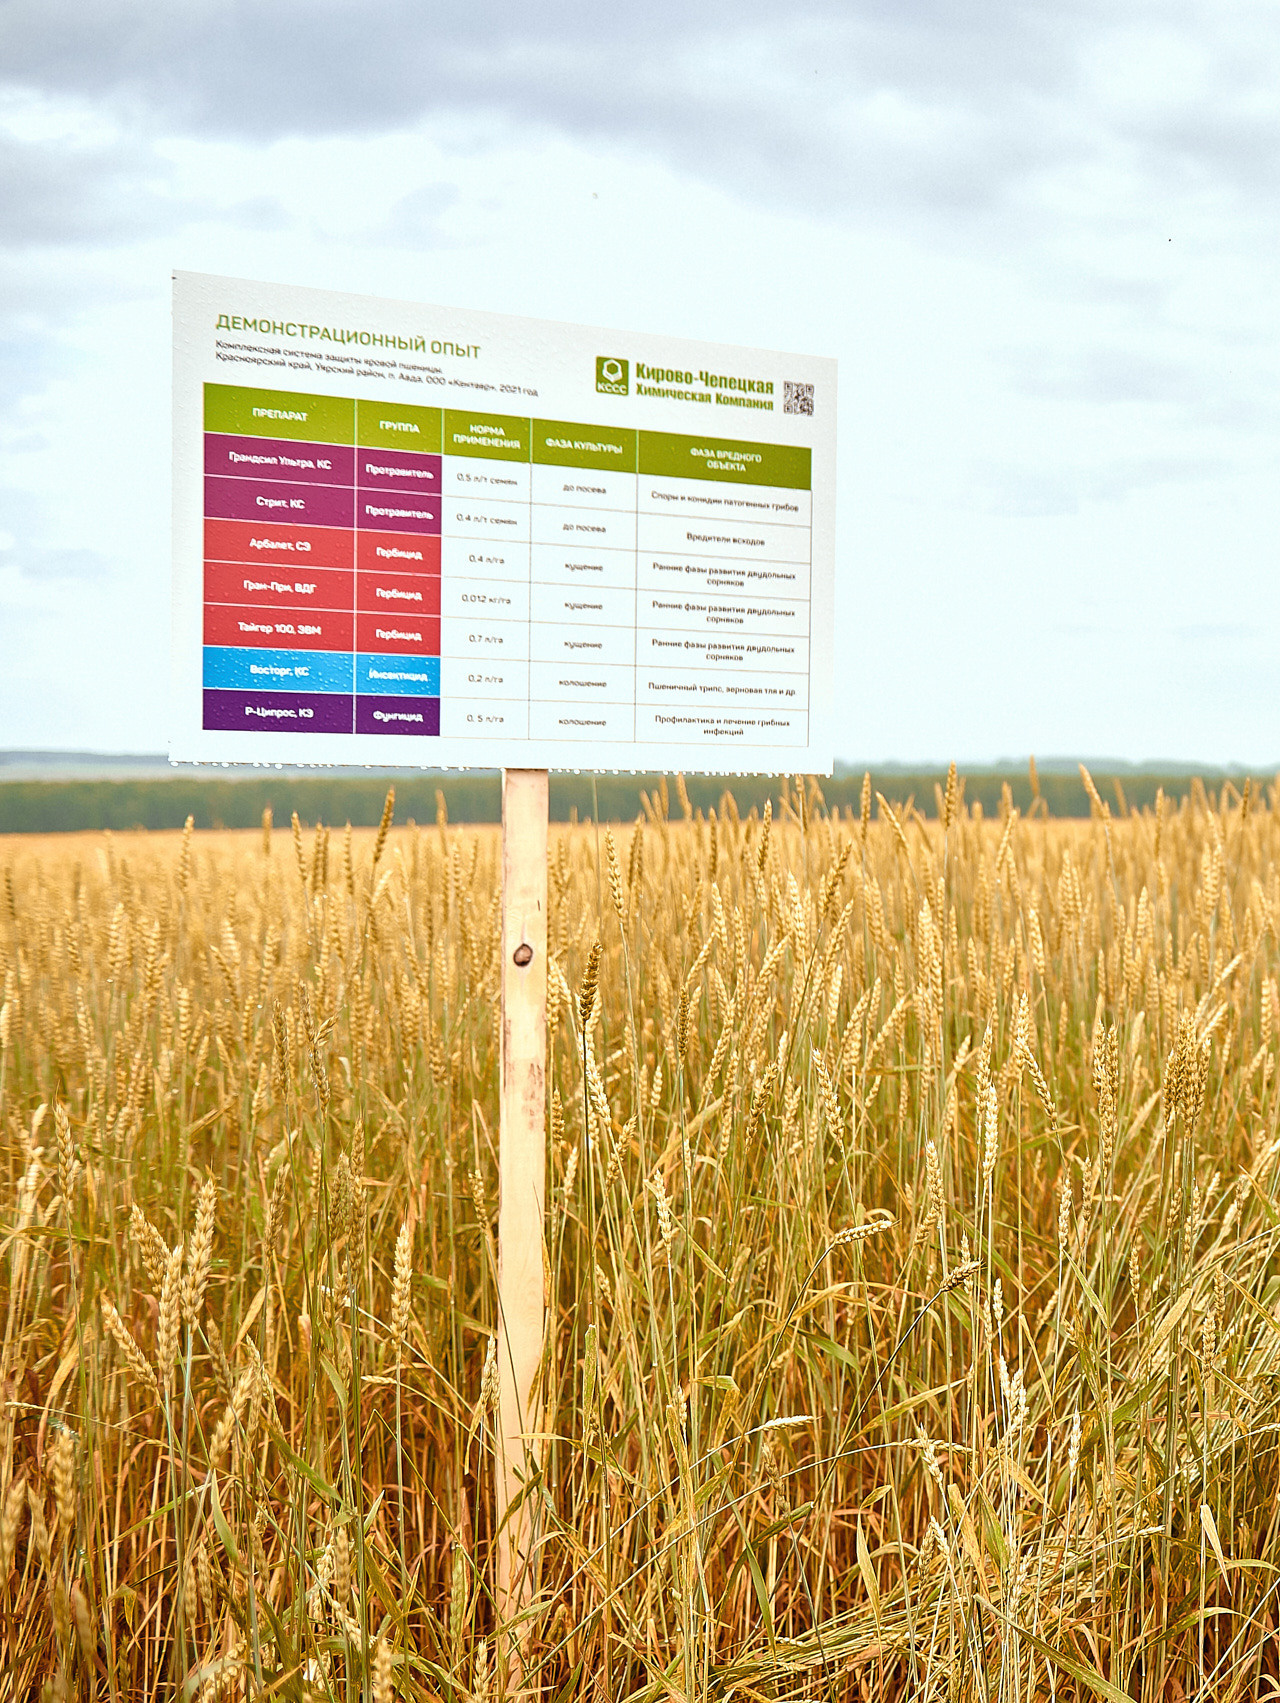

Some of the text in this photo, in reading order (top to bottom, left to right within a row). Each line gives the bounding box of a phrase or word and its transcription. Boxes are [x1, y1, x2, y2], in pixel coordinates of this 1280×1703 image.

[216, 313, 481, 359] ДЕМОНСТРАЦИОННЫЙ ОПЫТ
[215, 339, 281, 355] Комплексная
[283, 348, 323, 360] система
[325, 352, 361, 365] защиты
[364, 357, 397, 369] яровой
[215, 351, 286, 368] Красноярский
[425, 375, 446, 386] ООО
[499, 383, 521, 395] 2021
[523, 386, 539, 397] год
[636, 362, 774, 395] Кирово-Чепецкая
[636, 383, 774, 411] Химическая Компания
[252, 408, 308, 421] ПРЕПАРАТ
[379, 421, 420, 433] ГРУППА
[470, 425, 504, 436] НОРМА
[453, 434, 521, 449] ПРИМЕНЕНИЯ
[545, 438, 622, 454] ФАЗА КУЛЬТУРЫ
[229, 451, 276, 466] Грандсил
[316, 458, 332, 470] КС
[690, 448, 762, 463] ФАЗА ВРЕДНОГО
[365, 464, 434, 480] Протравитель
[707, 461, 746, 472] ОБЪЕКТА
[490, 478, 518, 486] семян
[563, 484, 606, 494] до посева
[290, 498, 305, 509] КС
[651, 490, 678, 502] Споры
[688, 496, 722, 506] конидии
[724, 498, 770, 509] патогенных
[772, 503, 799, 512] грибов
[365, 505, 434, 520] Протравитель
[490, 518, 517, 526] семян
[562, 523, 606, 533] до посева
[687, 532, 765, 546] Вредители всходов
[295, 541, 311, 552] СЭ
[376, 547, 423, 560] Гербицид
[565, 563, 603, 572] кущение
[653, 562, 796, 580] Ранние фазы развития двудольных
[294, 583, 317, 594] ВДГ
[707, 578, 744, 587] сорняков
[375, 588, 423, 601] Гербицид
[565, 602, 603, 611] кущение
[652, 600, 795, 618] Ранние фазы развития двудольных
[706, 616, 744, 624] сорняков
[237, 621, 273, 635] Тайгер
[375, 629, 422, 642] Гербицид
[564, 641, 602, 649] кущение
[652, 639, 795, 655] Ранние фазы развития двудольных
[706, 654, 743, 662] сорняков
[295, 666, 309, 678] КС
[369, 668, 428, 682] Инсектицид
[559, 680, 607, 688] колошение
[648, 682, 698, 692] Пшеничный
[699, 686, 724, 694] трипс,
[726, 687, 763, 695] зерновая
[299, 708, 314, 719] КЭ
[373, 710, 424, 723] Фунгицид
[655, 715, 715, 725] Профилактика
[558, 718, 607, 727] колошение
[704, 728, 744, 737] инфекций
